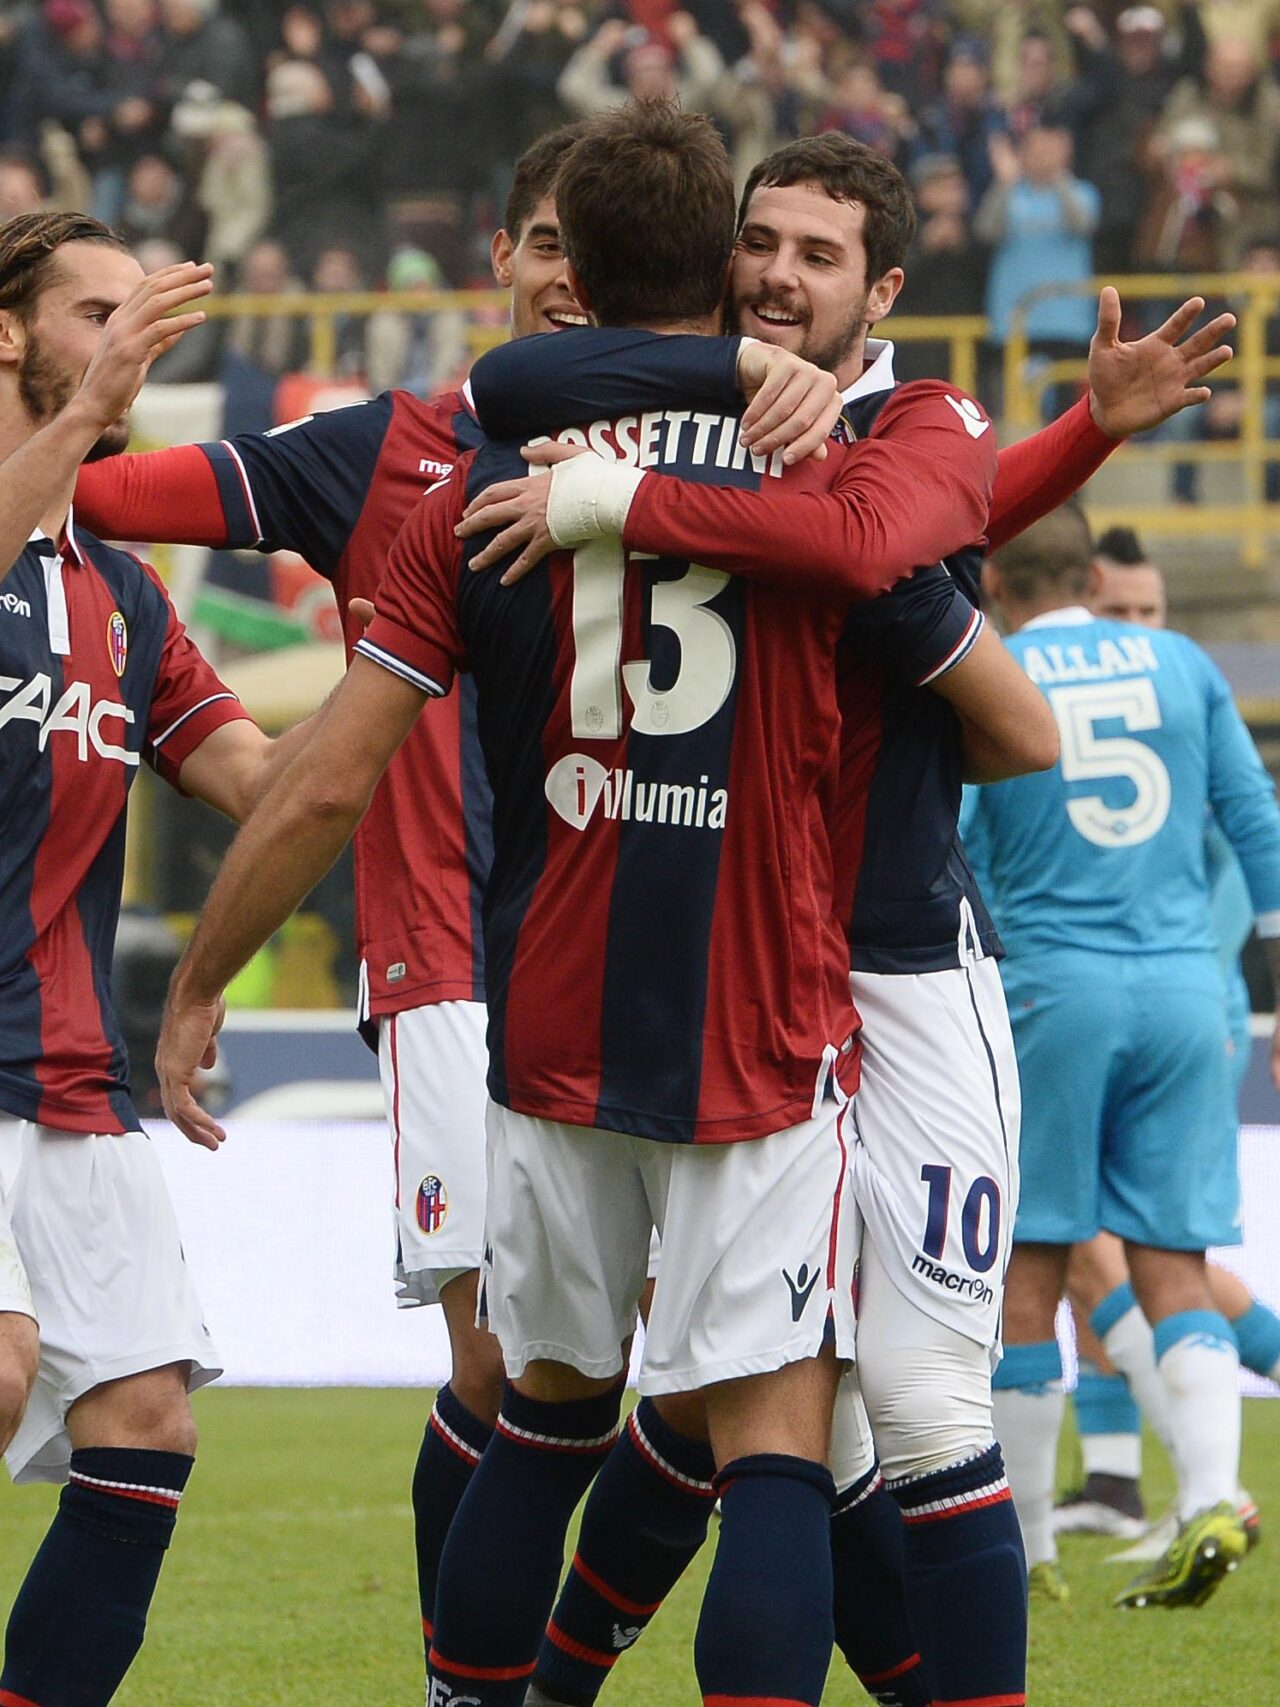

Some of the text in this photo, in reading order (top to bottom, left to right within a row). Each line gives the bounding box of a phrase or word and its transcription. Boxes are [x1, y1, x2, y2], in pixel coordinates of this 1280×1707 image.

[572, 536, 737, 740] 13
[1023, 636, 1159, 684] ALLAN
[604, 768, 729, 830] illumia
[1048, 676, 1171, 848] 5
[920, 1164, 1000, 1273] 10
[912, 1254, 993, 1305] macron
